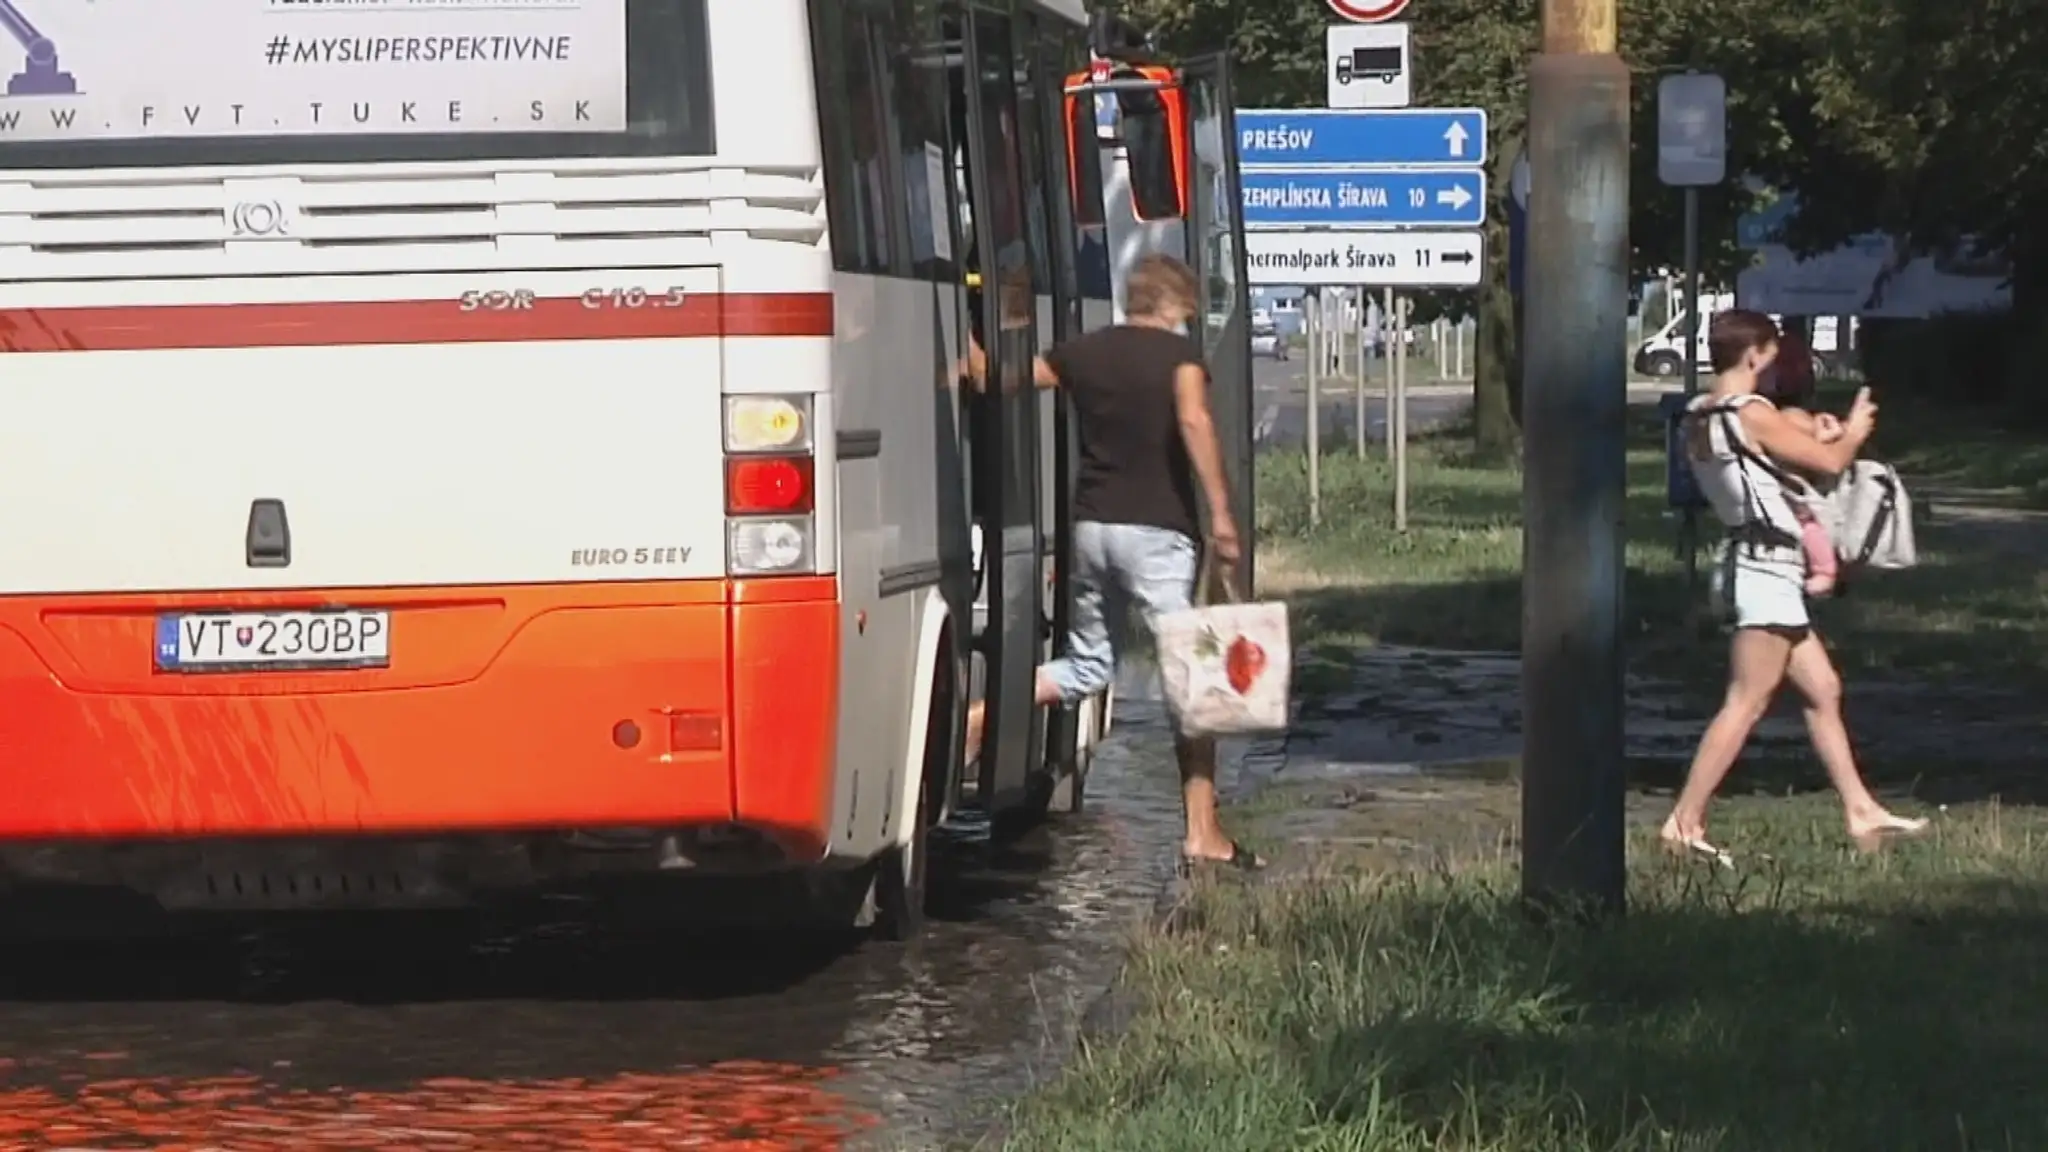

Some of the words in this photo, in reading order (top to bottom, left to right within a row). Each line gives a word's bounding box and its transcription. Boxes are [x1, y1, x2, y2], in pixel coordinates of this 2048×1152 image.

[265, 35, 571, 65] #MYSLIPERSPEKTIVNE
[1242, 124, 1314, 150] PREŠOV
[1242, 182, 1331, 208] ZEMPLÍNSKA
[1337, 181, 1389, 208] ŠÍRAVA
[1408, 187, 1426, 208] 10
[1415, 249, 1431, 268] 11
[459, 288, 536, 312] SOR
[571, 548, 628, 566] EURO
[634, 547, 649, 564] 5
[186, 619, 232, 656] VT
[257, 617, 381, 656] 230BP
